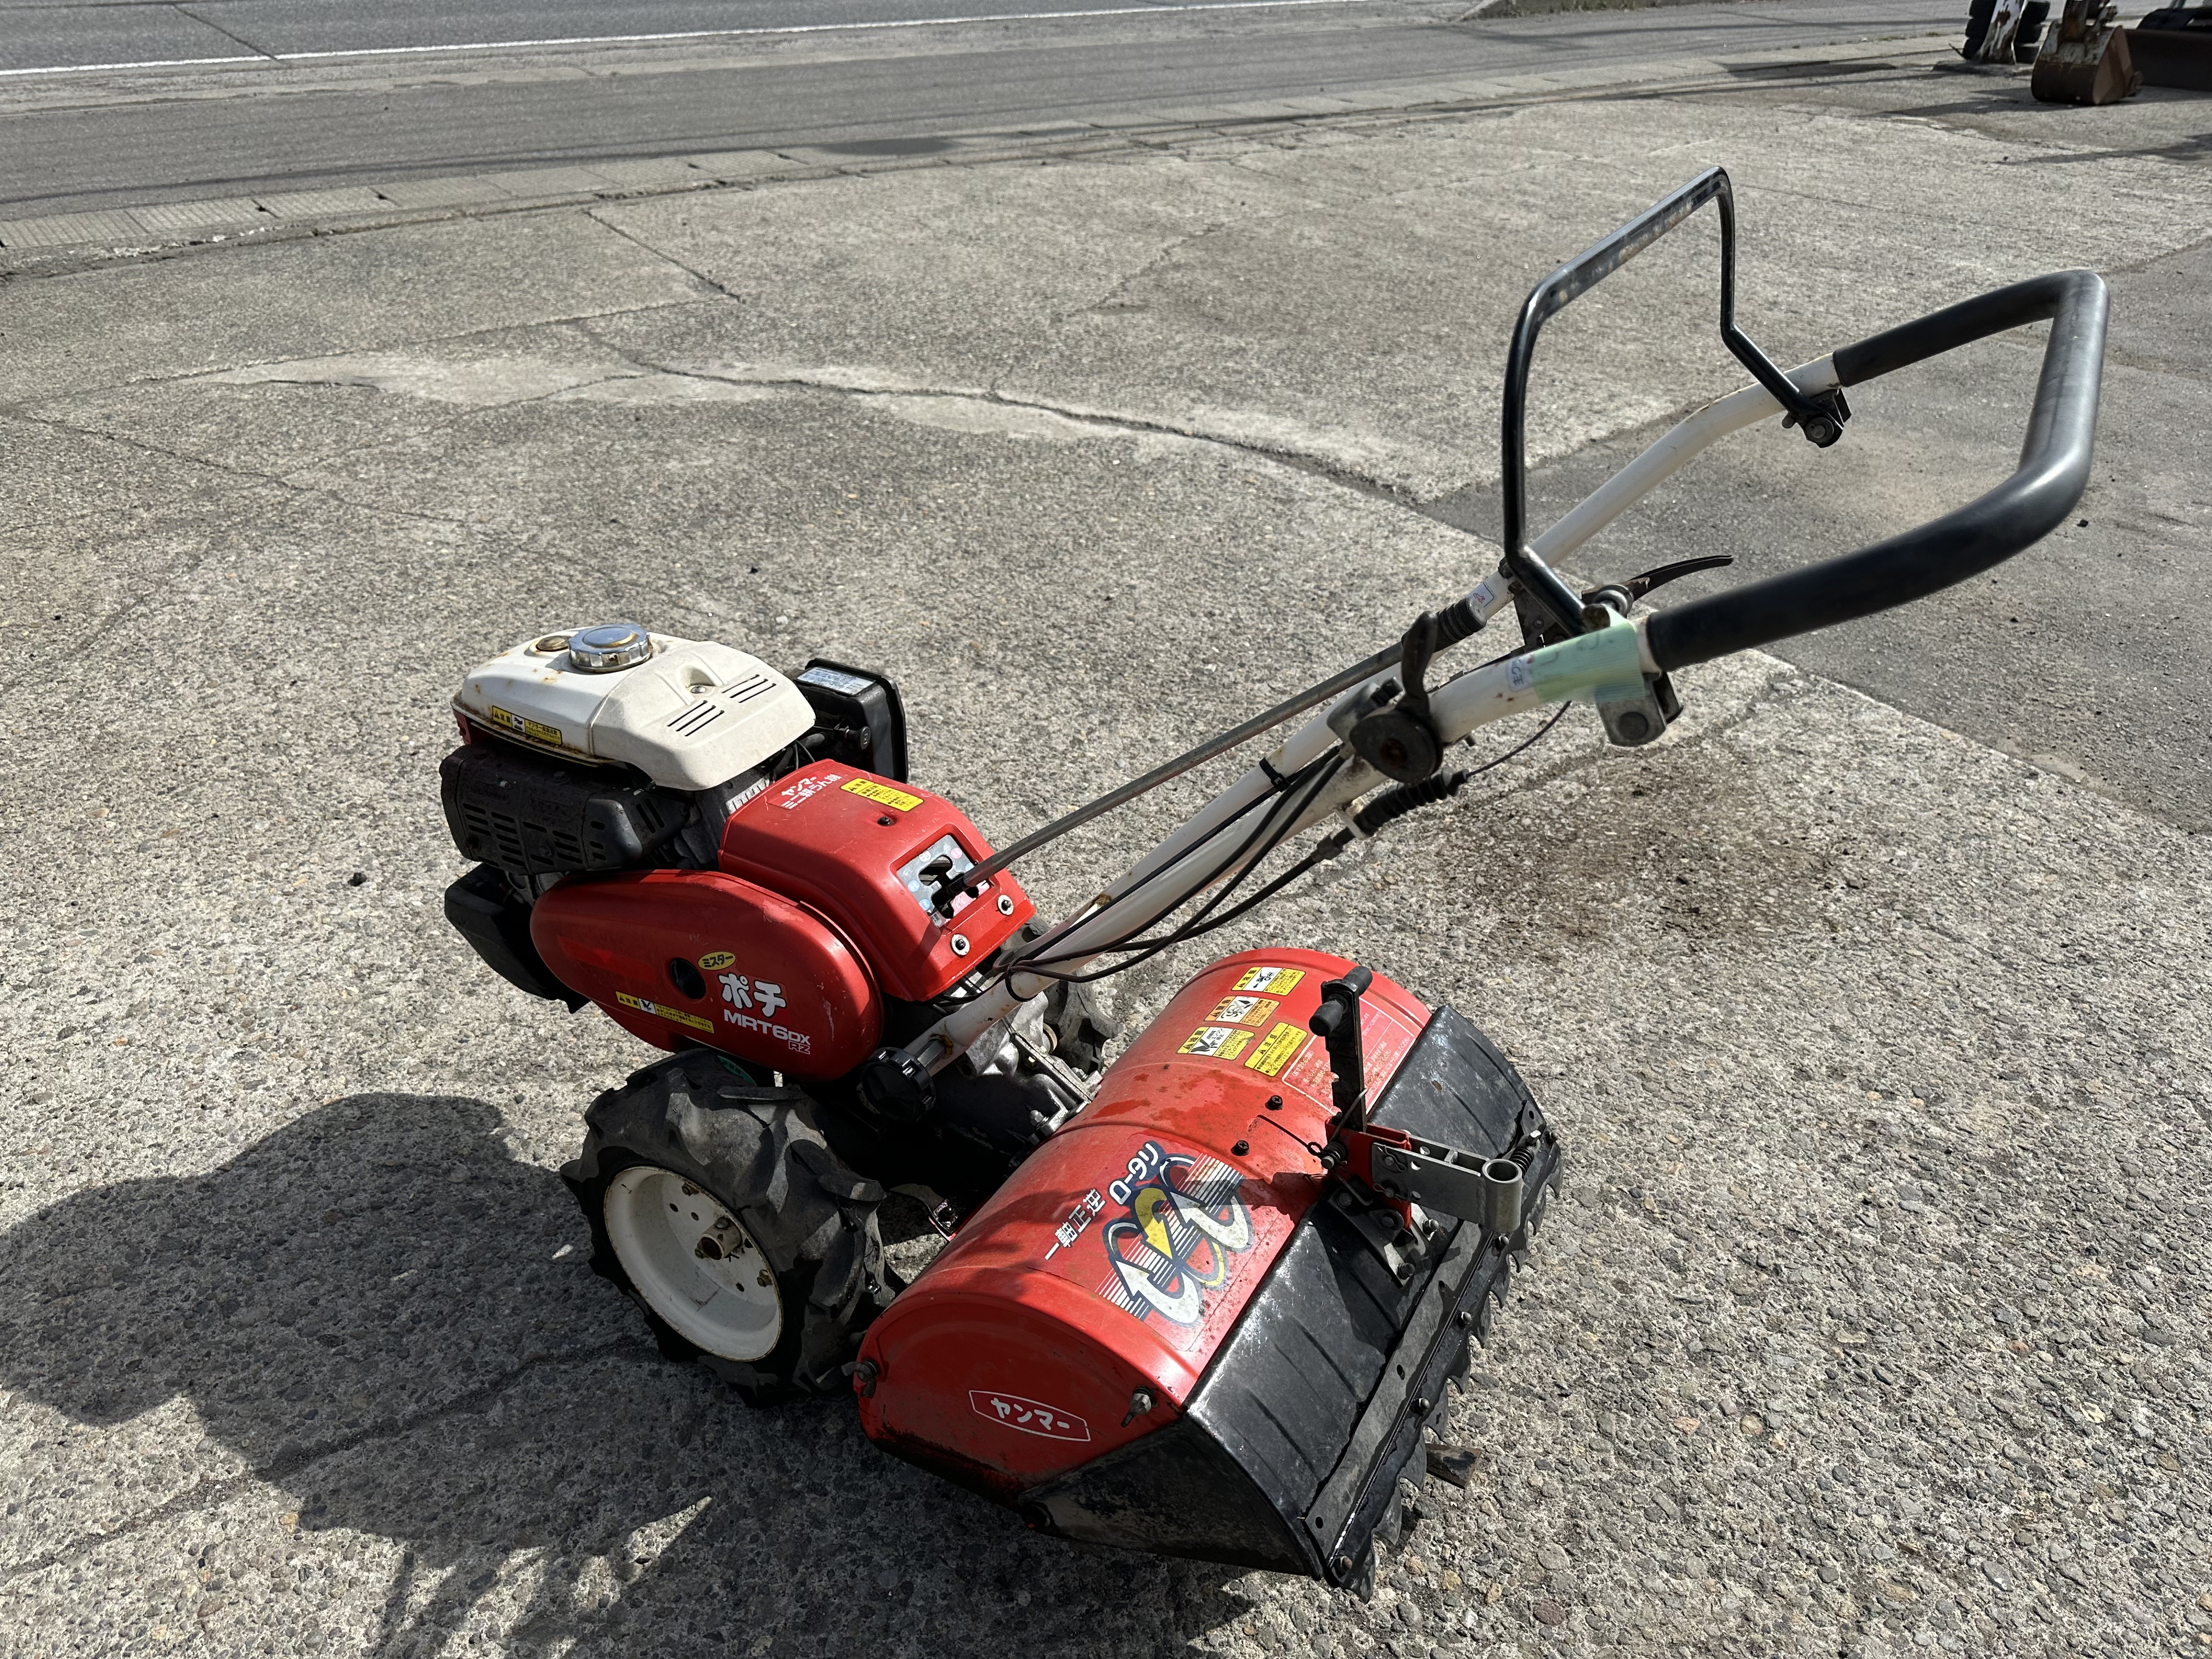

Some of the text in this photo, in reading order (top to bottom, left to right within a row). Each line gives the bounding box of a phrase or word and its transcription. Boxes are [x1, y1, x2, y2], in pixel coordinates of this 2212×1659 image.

[781, 776, 817, 796] ヤンマー
[702, 953, 733, 968] ミスター
[718, 973, 786, 1017] ポチ
[724, 1008, 811, 1045] MRT6DX
[788, 1040, 811, 1055] RZ
[1045, 1143, 1159, 1260] 一軸正逆 ロータリ
[990, 1397, 1070, 1430] ヤンマー
